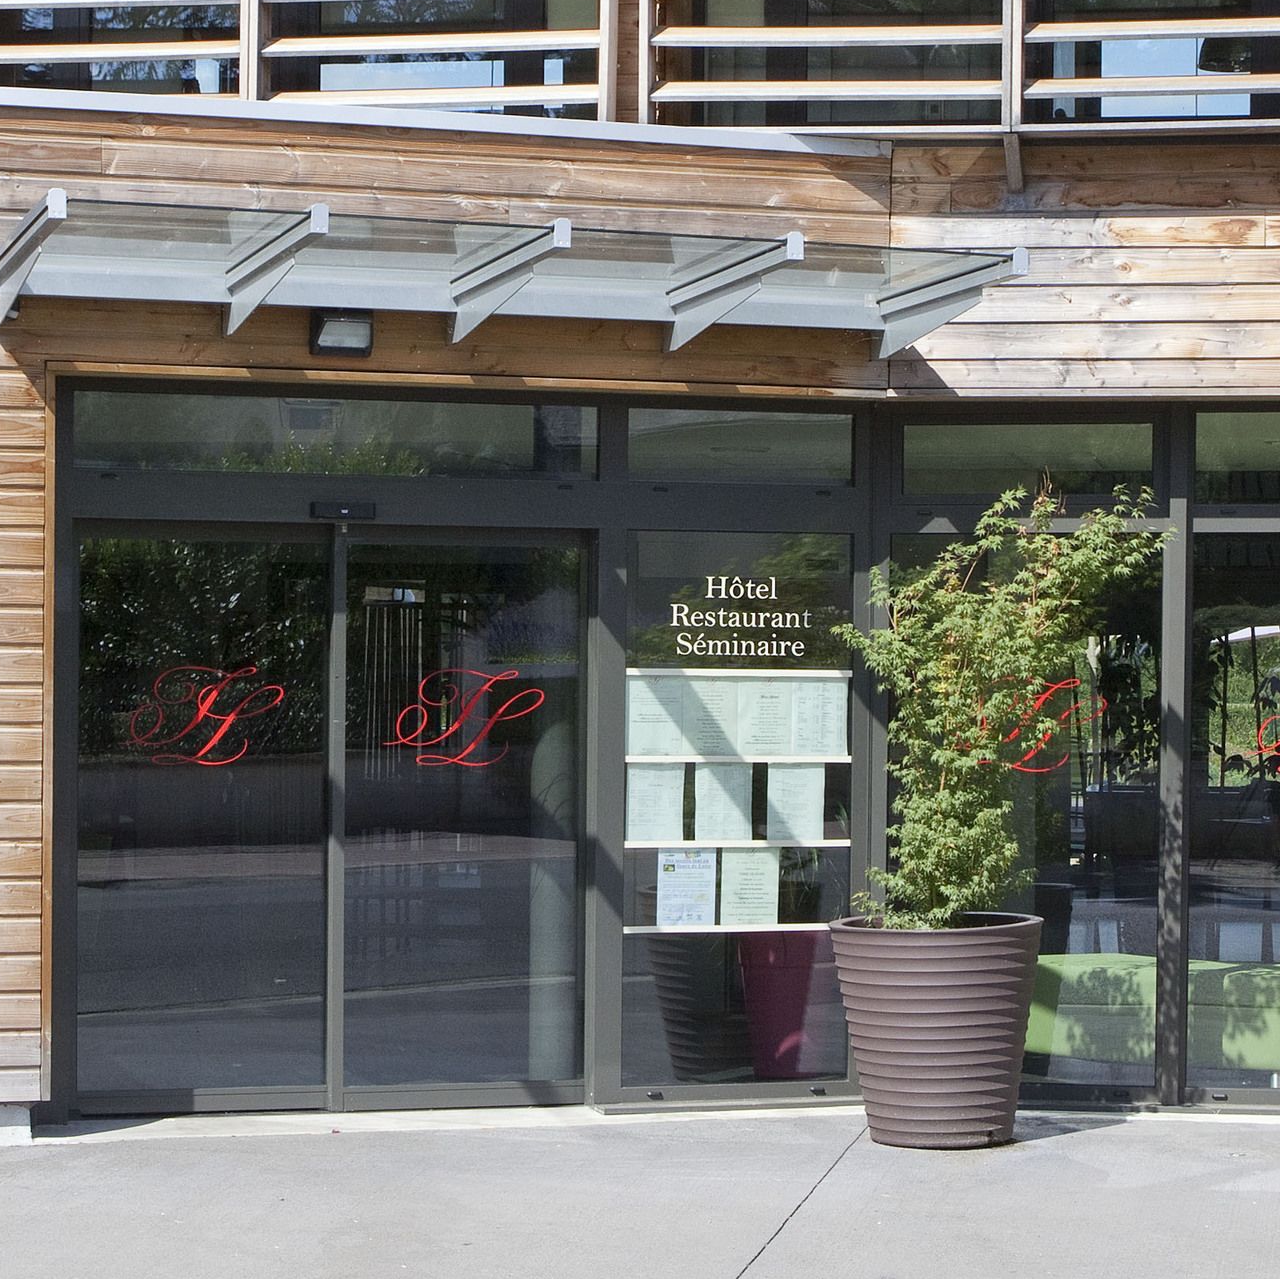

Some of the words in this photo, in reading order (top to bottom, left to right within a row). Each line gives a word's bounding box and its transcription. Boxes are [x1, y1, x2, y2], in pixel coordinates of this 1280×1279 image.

[705, 576, 778, 600] Hôtel
[670, 604, 812, 629] Restaurant
[676, 633, 806, 657] Séminaire
